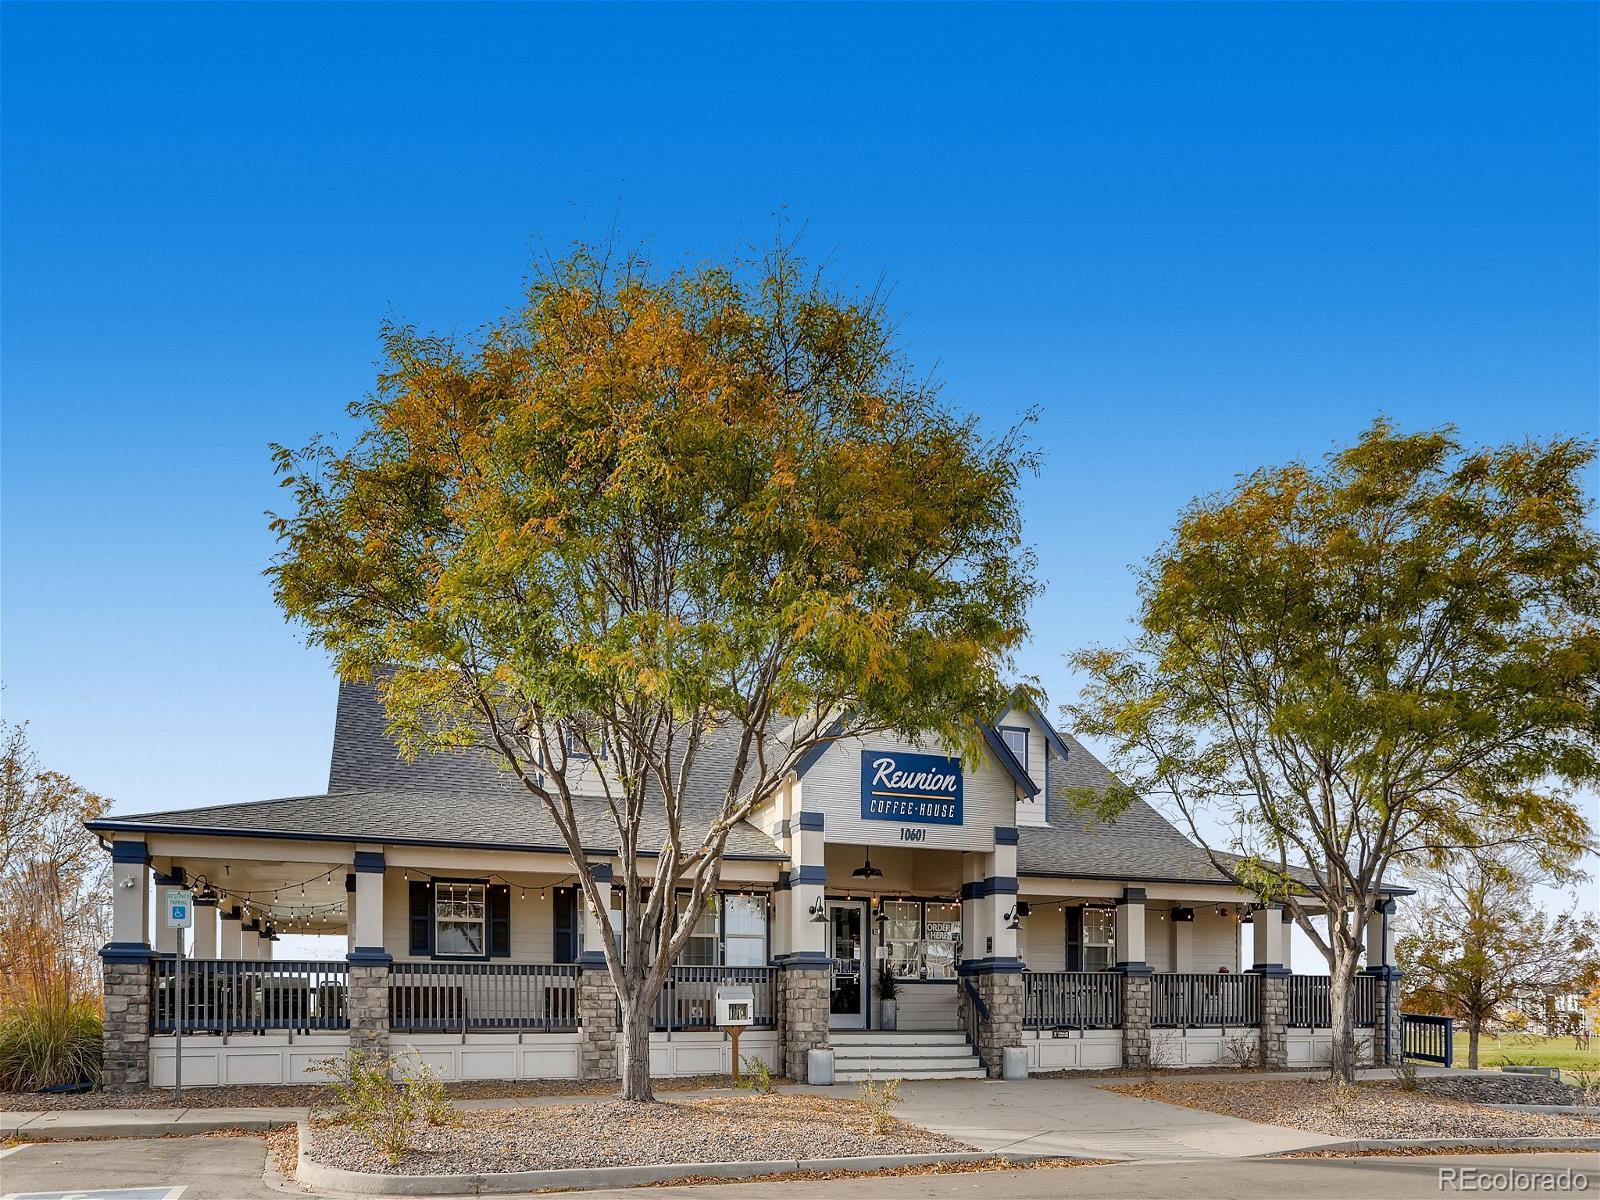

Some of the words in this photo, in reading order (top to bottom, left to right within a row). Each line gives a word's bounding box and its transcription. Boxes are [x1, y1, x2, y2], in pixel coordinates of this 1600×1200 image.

[872, 758, 957, 792] Reunion
[900, 827, 926, 842] 10601
[927, 923, 951, 932] ORDER
